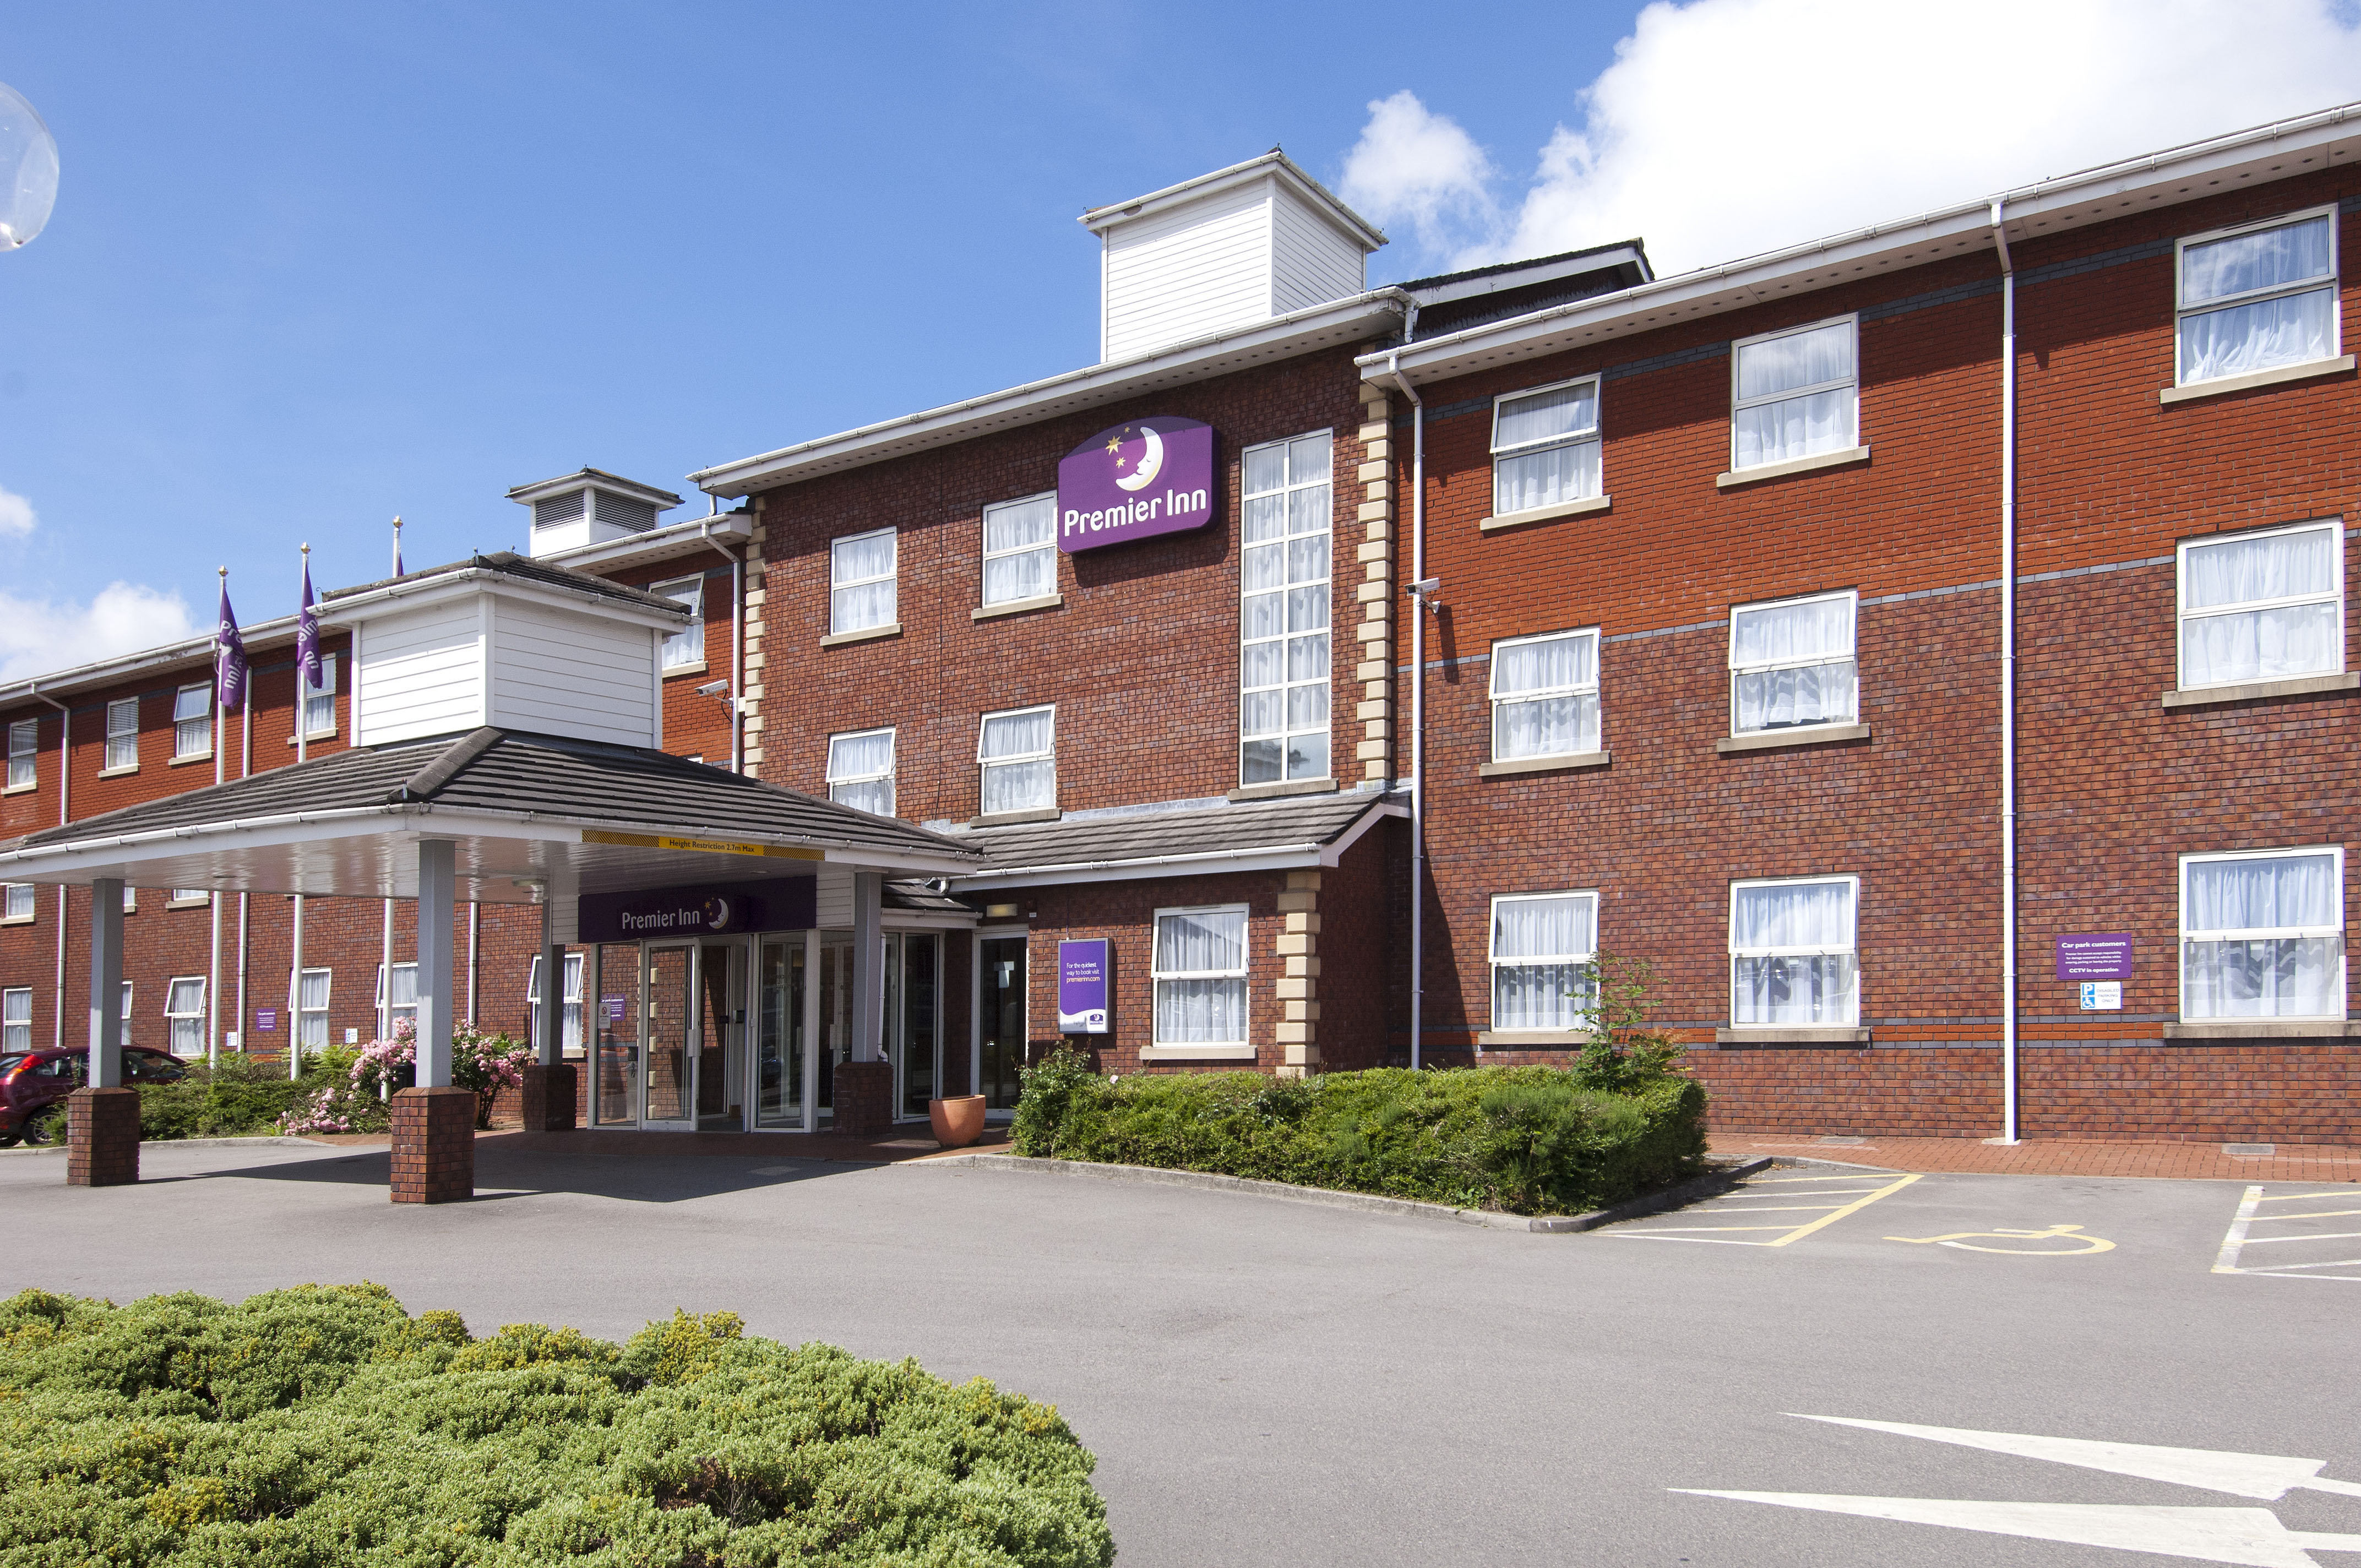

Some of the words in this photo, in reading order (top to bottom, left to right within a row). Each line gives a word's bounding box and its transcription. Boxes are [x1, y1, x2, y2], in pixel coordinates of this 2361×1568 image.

[1064, 497, 1162, 537] Premier
[1167, 489, 1206, 516] Inn
[669, 840, 690, 848] Height
[692, 841, 725, 850] Restriction
[622, 910, 676, 929] Premier
[679, 908, 700, 925] Inn
[1067, 976, 1100, 984] premierinn.com
